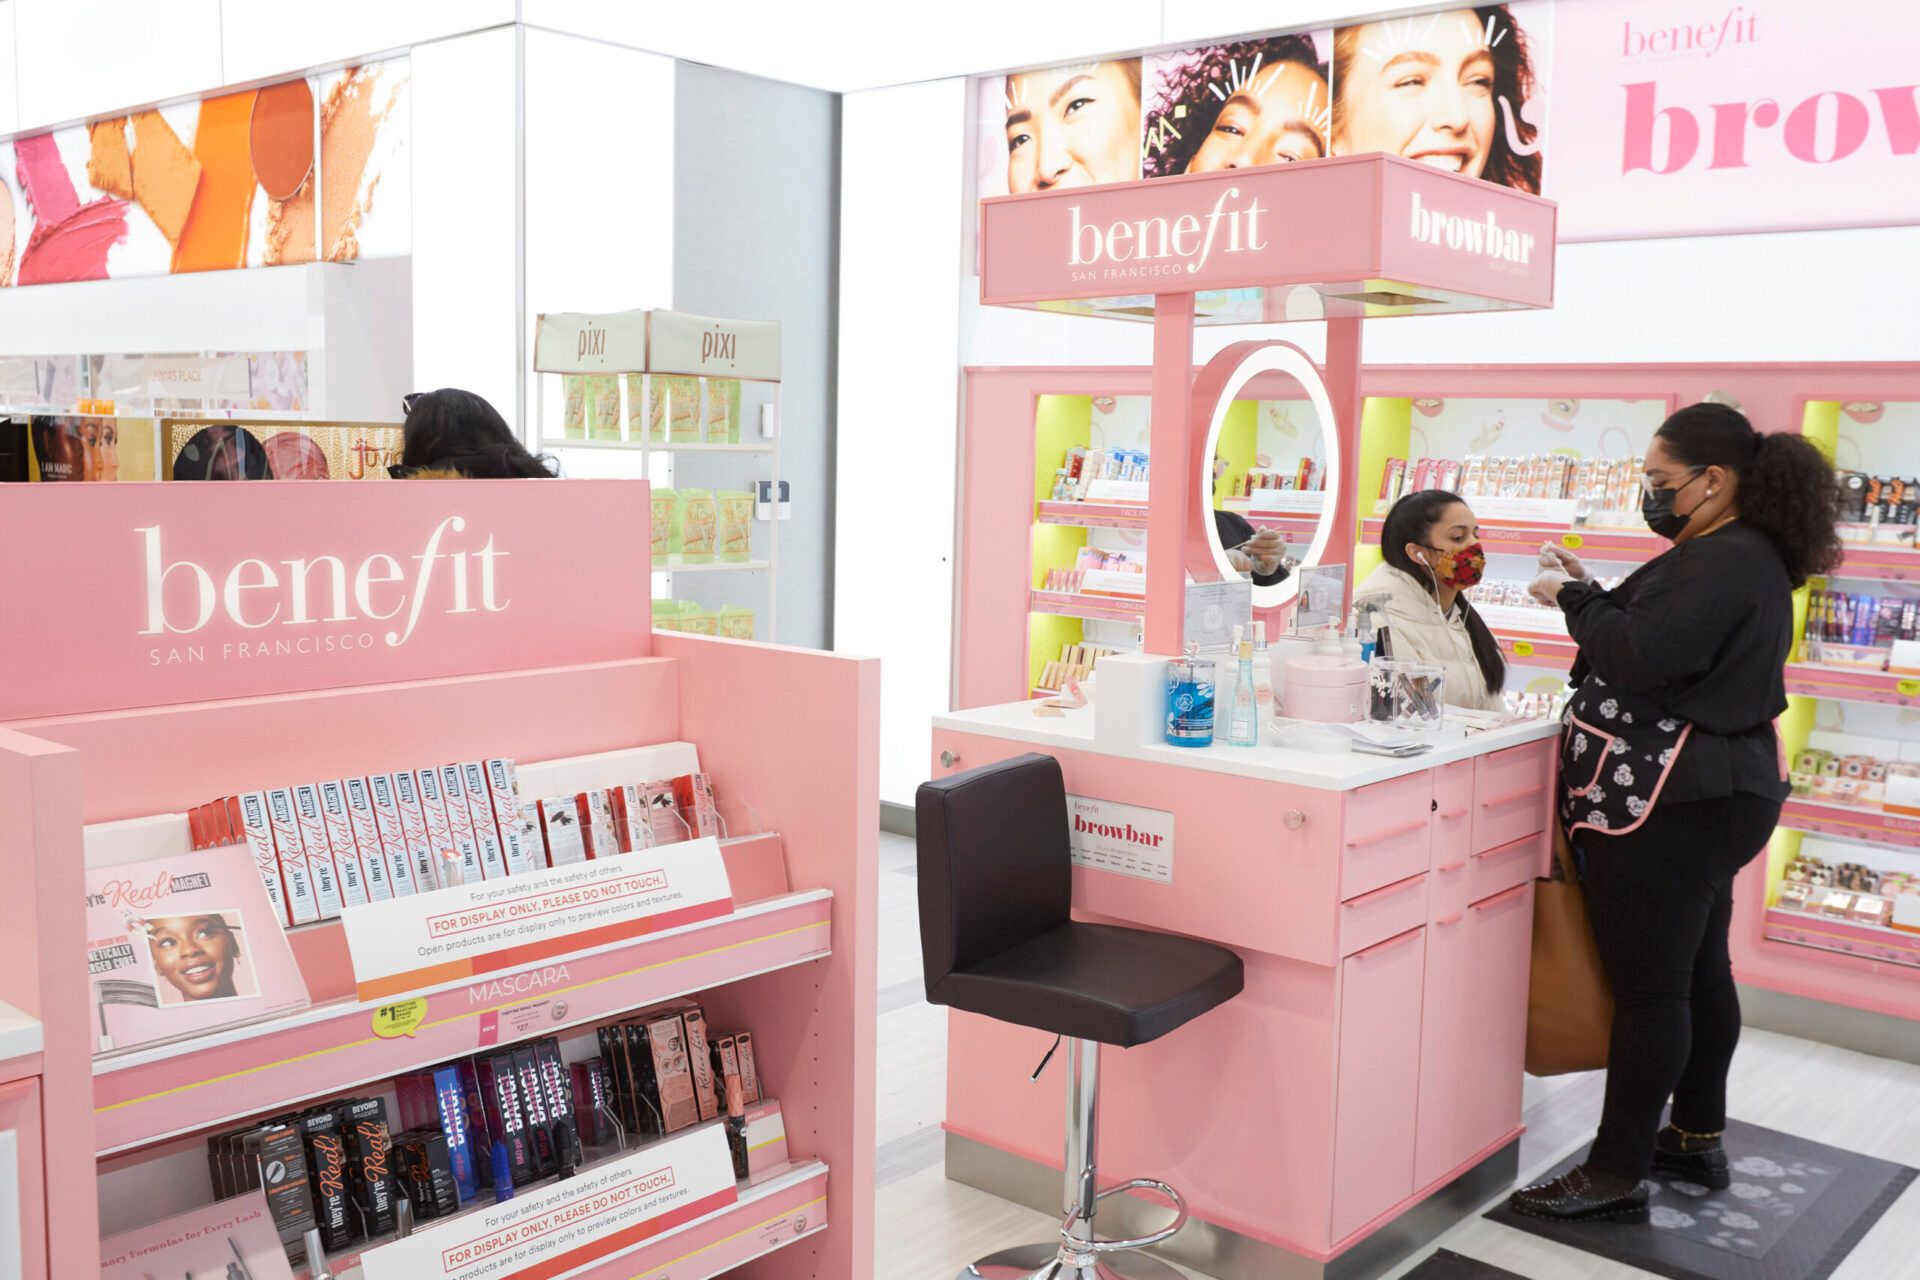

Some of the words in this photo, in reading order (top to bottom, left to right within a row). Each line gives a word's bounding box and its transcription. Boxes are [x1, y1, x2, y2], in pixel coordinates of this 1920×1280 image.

[1620, 6, 1761, 57] benefit
[1067, 187, 1268, 273] benefit
[1411, 191, 1535, 264] browbar
[1071, 271, 1097, 282] SAN
[1104, 264, 1182, 280] FRANCISCO
[133, 514, 511, 647] benefit
[150, 645, 205, 666] SAN
[223, 632, 375, 660] FRANCISCO
[1075, 814, 1163, 847] browbar
[103, 871, 174, 909] Real!
[171, 872, 211, 893] MAGNET
[434, 918, 458, 932] FOR
[460, 908, 506, 927] DISPLAY
[508, 901, 542, 916] ONLY,
[542, 892, 580, 909] PLEASE
[582, 889, 599, 900] DO
[601, 884, 622, 897] NOT
[623, 876, 664, 891] TOUCH.
[470, 892, 486, 901] For
[486, 888, 504, 900] your
[507, 883, 531, 895] safety
[533, 878, 549, 889] and
[549, 875, 563, 886] the
[564, 870, 588, 884] safety
[589, 868, 598, 878] of
[598, 864, 623, 877] others
[417, 943, 444, 957] Open
[445, 934, 486, 952] products
[487, 930, 501, 941] are
[502, 926, 516, 937] for
[517, 919, 546, 935] display
[549, 915, 566, 928] only
[567, 914, 577, 922] to
[578, 907, 609, 921] preview
[611, 902, 635, 914] colors
[636, 898, 650, 907] and
[652, 891, 683, 904] textures.
[88, 944, 134, 961] NETICALLY
[468, 965, 571, 1005] MASCARA
[352, 1101, 378, 1114] BEYOND
[498, 1069, 523, 1136] BANG!
[520, 1062, 546, 1127] BANG!
[542, 1055, 567, 1120] BANG!
[307, 1114, 332, 1127] BEYOND
[440, 1082, 466, 1150] BANG!
[313, 1135, 344, 1198] Real!
[357, 1121, 389, 1182] Real!
[329, 1195, 344, 1228] they're
[374, 1181, 389, 1212] they're
[449, 1248, 471, 1265] FOR
[474, 1230, 519, 1256] DISPLAY
[521, 1219, 553, 1237] ONLY,
[554, 1203, 591, 1225] PLEASE
[593, 1197, 608, 1210] DO
[610, 1187, 632, 1202] NOT
[633, 1174, 671, 1194] TOUCH.
[485, 1218, 499, 1228] For
[501, 1210, 518, 1224] your
[520, 1201, 544, 1215] safety
[546, 1195, 560, 1205] and
[561, 1190, 575, 1199] the
[576, 1181, 598, 1196] safety
[600, 1175, 608, 1185] of
[609, 1168, 632, 1182] others
[129, 1237, 184, 1259] Formulas
[185, 1230, 203, 1241] for
[203, 1220, 234, 1235] Every
[235, 1211, 261, 1225] Lash
[459, 1261, 497, 1280] products
[500, 1255, 513, 1267] are
[514, 1250, 527, 1261] for
[529, 1238, 557, 1254] display
[559, 1231, 575, 1244] only
[577, 1227, 586, 1236] to
[587, 1215, 618, 1233] preview
[619, 1207, 642, 1219] colors
[643, 1199, 657, 1210] and
[659, 1187, 690, 1204] textures.
